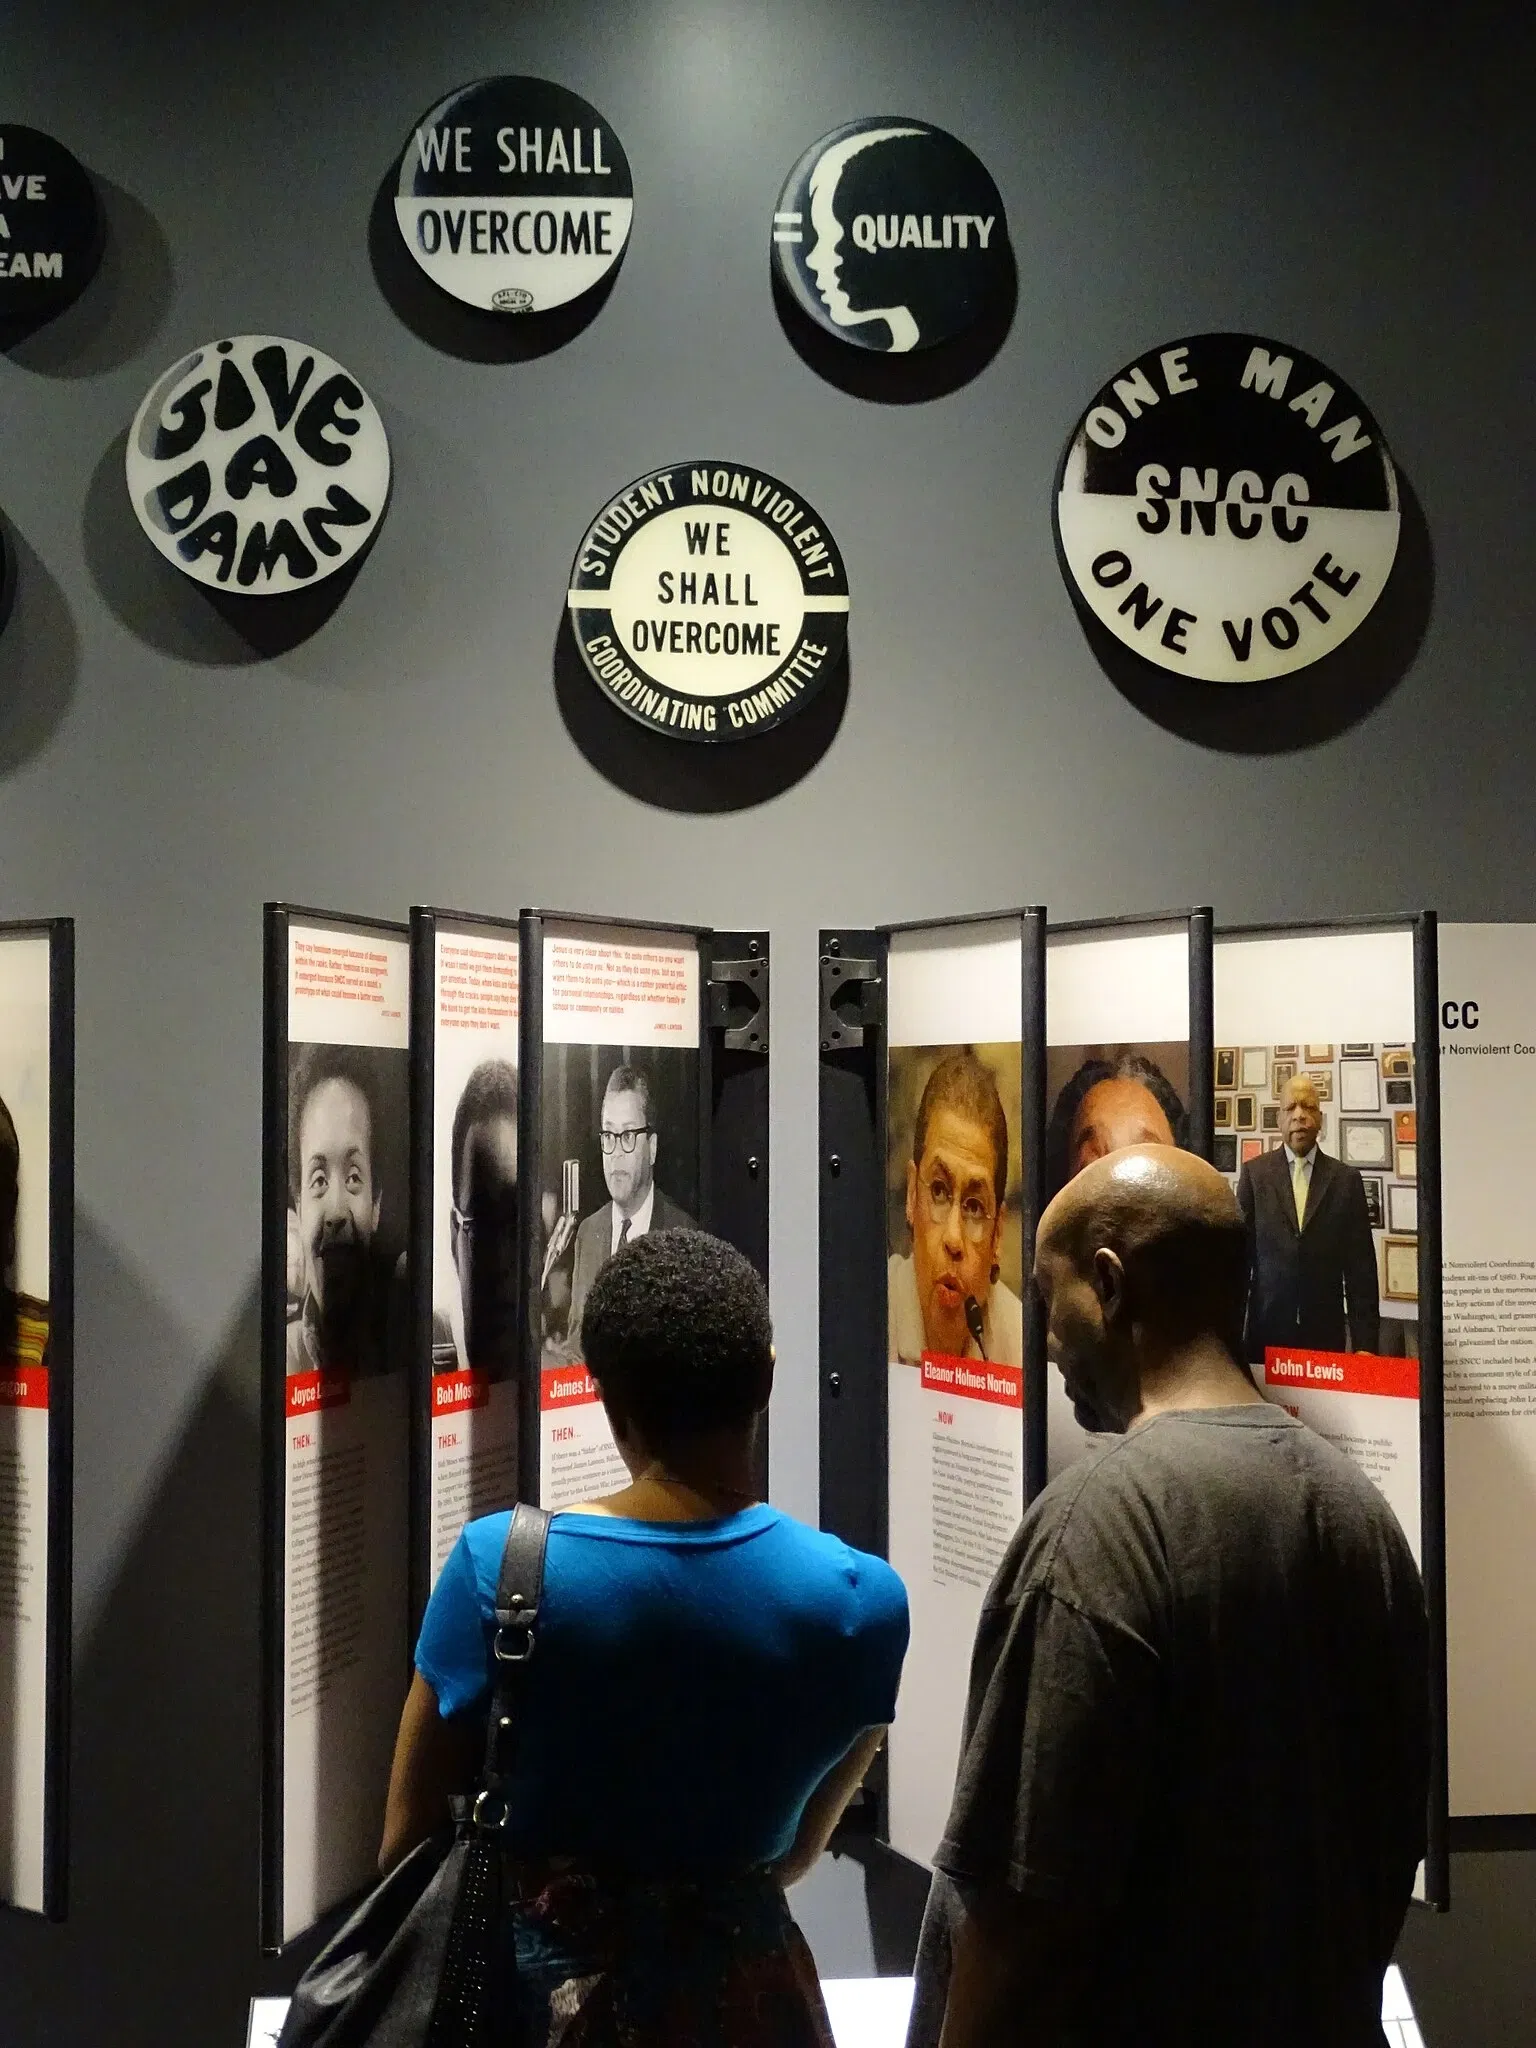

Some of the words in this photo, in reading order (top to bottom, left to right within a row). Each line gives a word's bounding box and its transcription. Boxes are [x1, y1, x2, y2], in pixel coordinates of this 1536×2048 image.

[416, 127, 471, 173] WE
[496, 127, 611, 174] SHALL
[0, 175, 47, 200] VE
[418, 209, 612, 255] OVERCOME
[852, 214, 996, 254] QUALITY
[1086, 347, 1199, 448] ONE
[1240, 347, 1372, 462] MAN
[224, 434, 297, 500] A
[1136, 463, 1310, 543] SNCC
[143, 460, 371, 586] DAMN
[580, 475, 675, 577] STUDENT
[691, 470, 836, 579] NONVIOLENT
[684, 521, 731, 557] WE
[658, 570, 759, 607] SHALL
[1091, 550, 1198, 655] ONE
[1222, 553, 1361, 662] VOTE
[633, 619, 782, 656] OVERCOME
[587, 634, 718, 731] COORDINATING
[726, 640, 829, 729] COMMITTEE
[1449, 1043, 1510, 1055] Nonviolent
[924, 1360, 954, 1383] Eleanor
[955, 1366, 986, 1390] Holmes
[987, 1373, 1017, 1397] Norton
[1271, 1357, 1304, 1377] John
[1306, 1360, 1345, 1382] Lewis
[291, 1385, 316, 1407] Joyce
[436, 1383, 454, 1406] Bob
[549, 1379, 583, 1399] James
